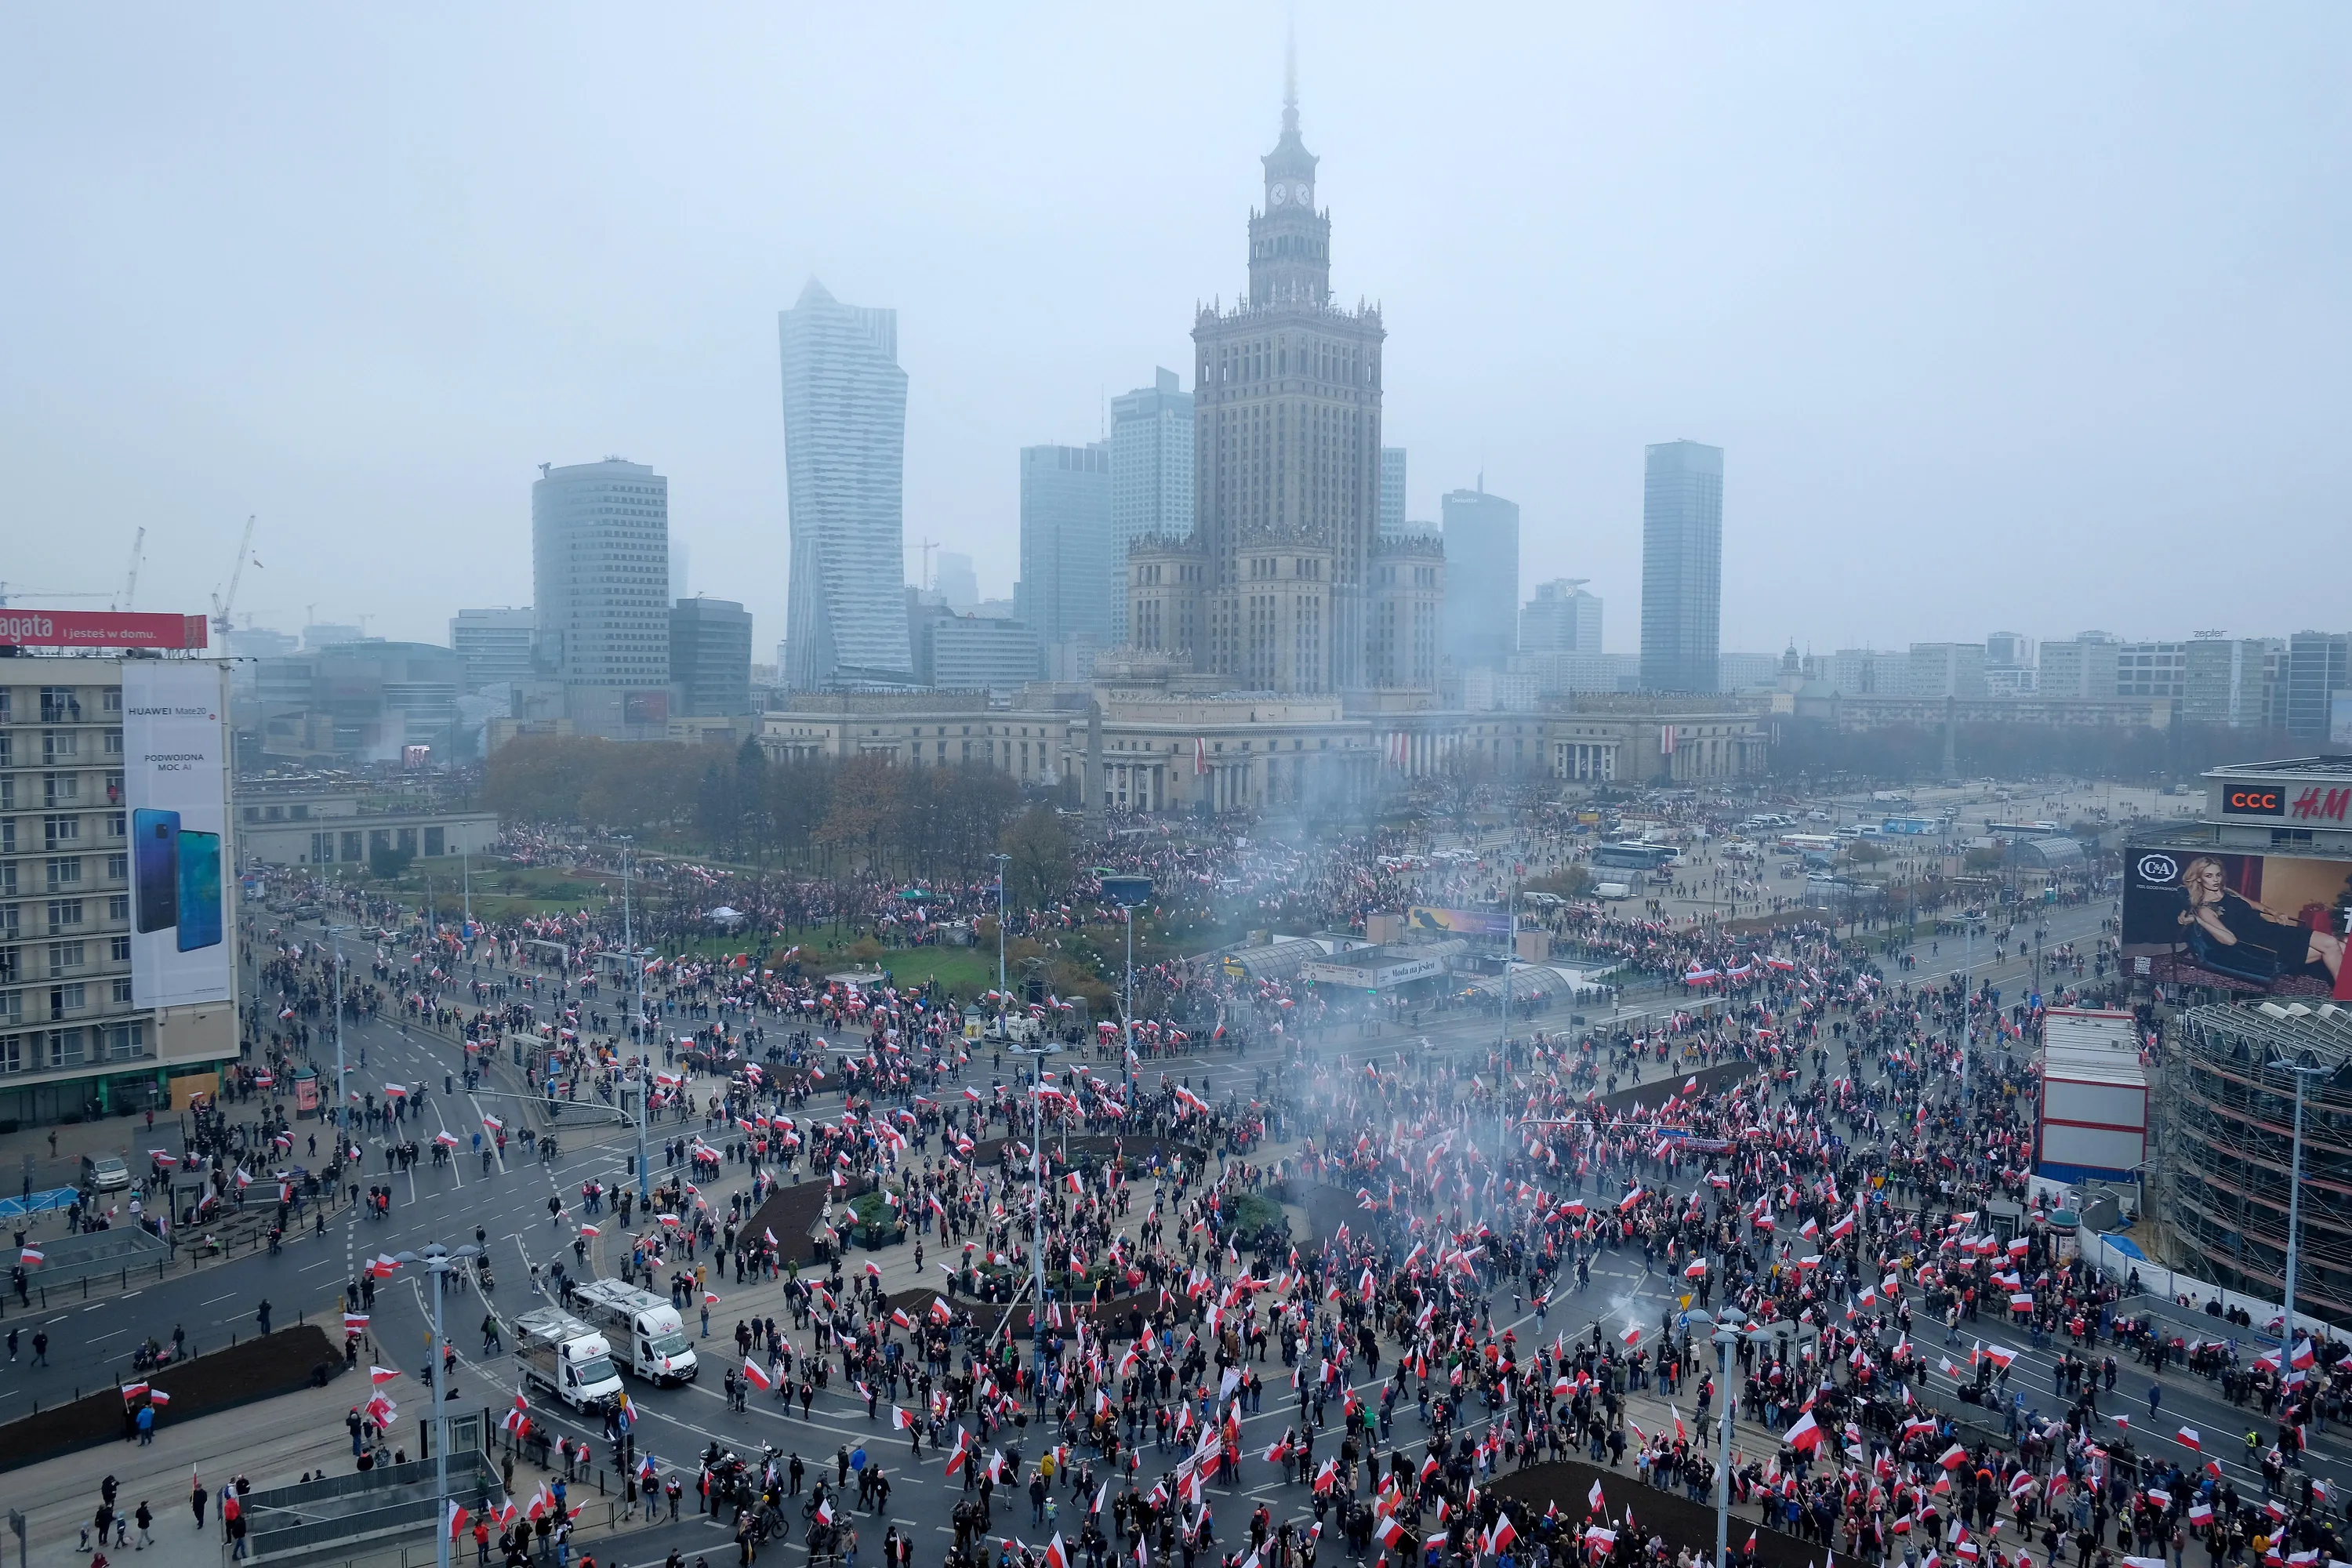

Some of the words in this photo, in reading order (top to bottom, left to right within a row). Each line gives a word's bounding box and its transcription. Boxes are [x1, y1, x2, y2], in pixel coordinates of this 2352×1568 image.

[0, 615, 53, 643] agata
[69, 628, 105, 640] jesteś
[107, 630, 118, 639] w
[120, 628, 157, 639] domu.
[2231, 793, 2277, 809] CCC
[2292, 786, 2351, 822] H&M
[2145, 861, 2172, 875] C&A
[1392, 966, 1409, 977] Moda
